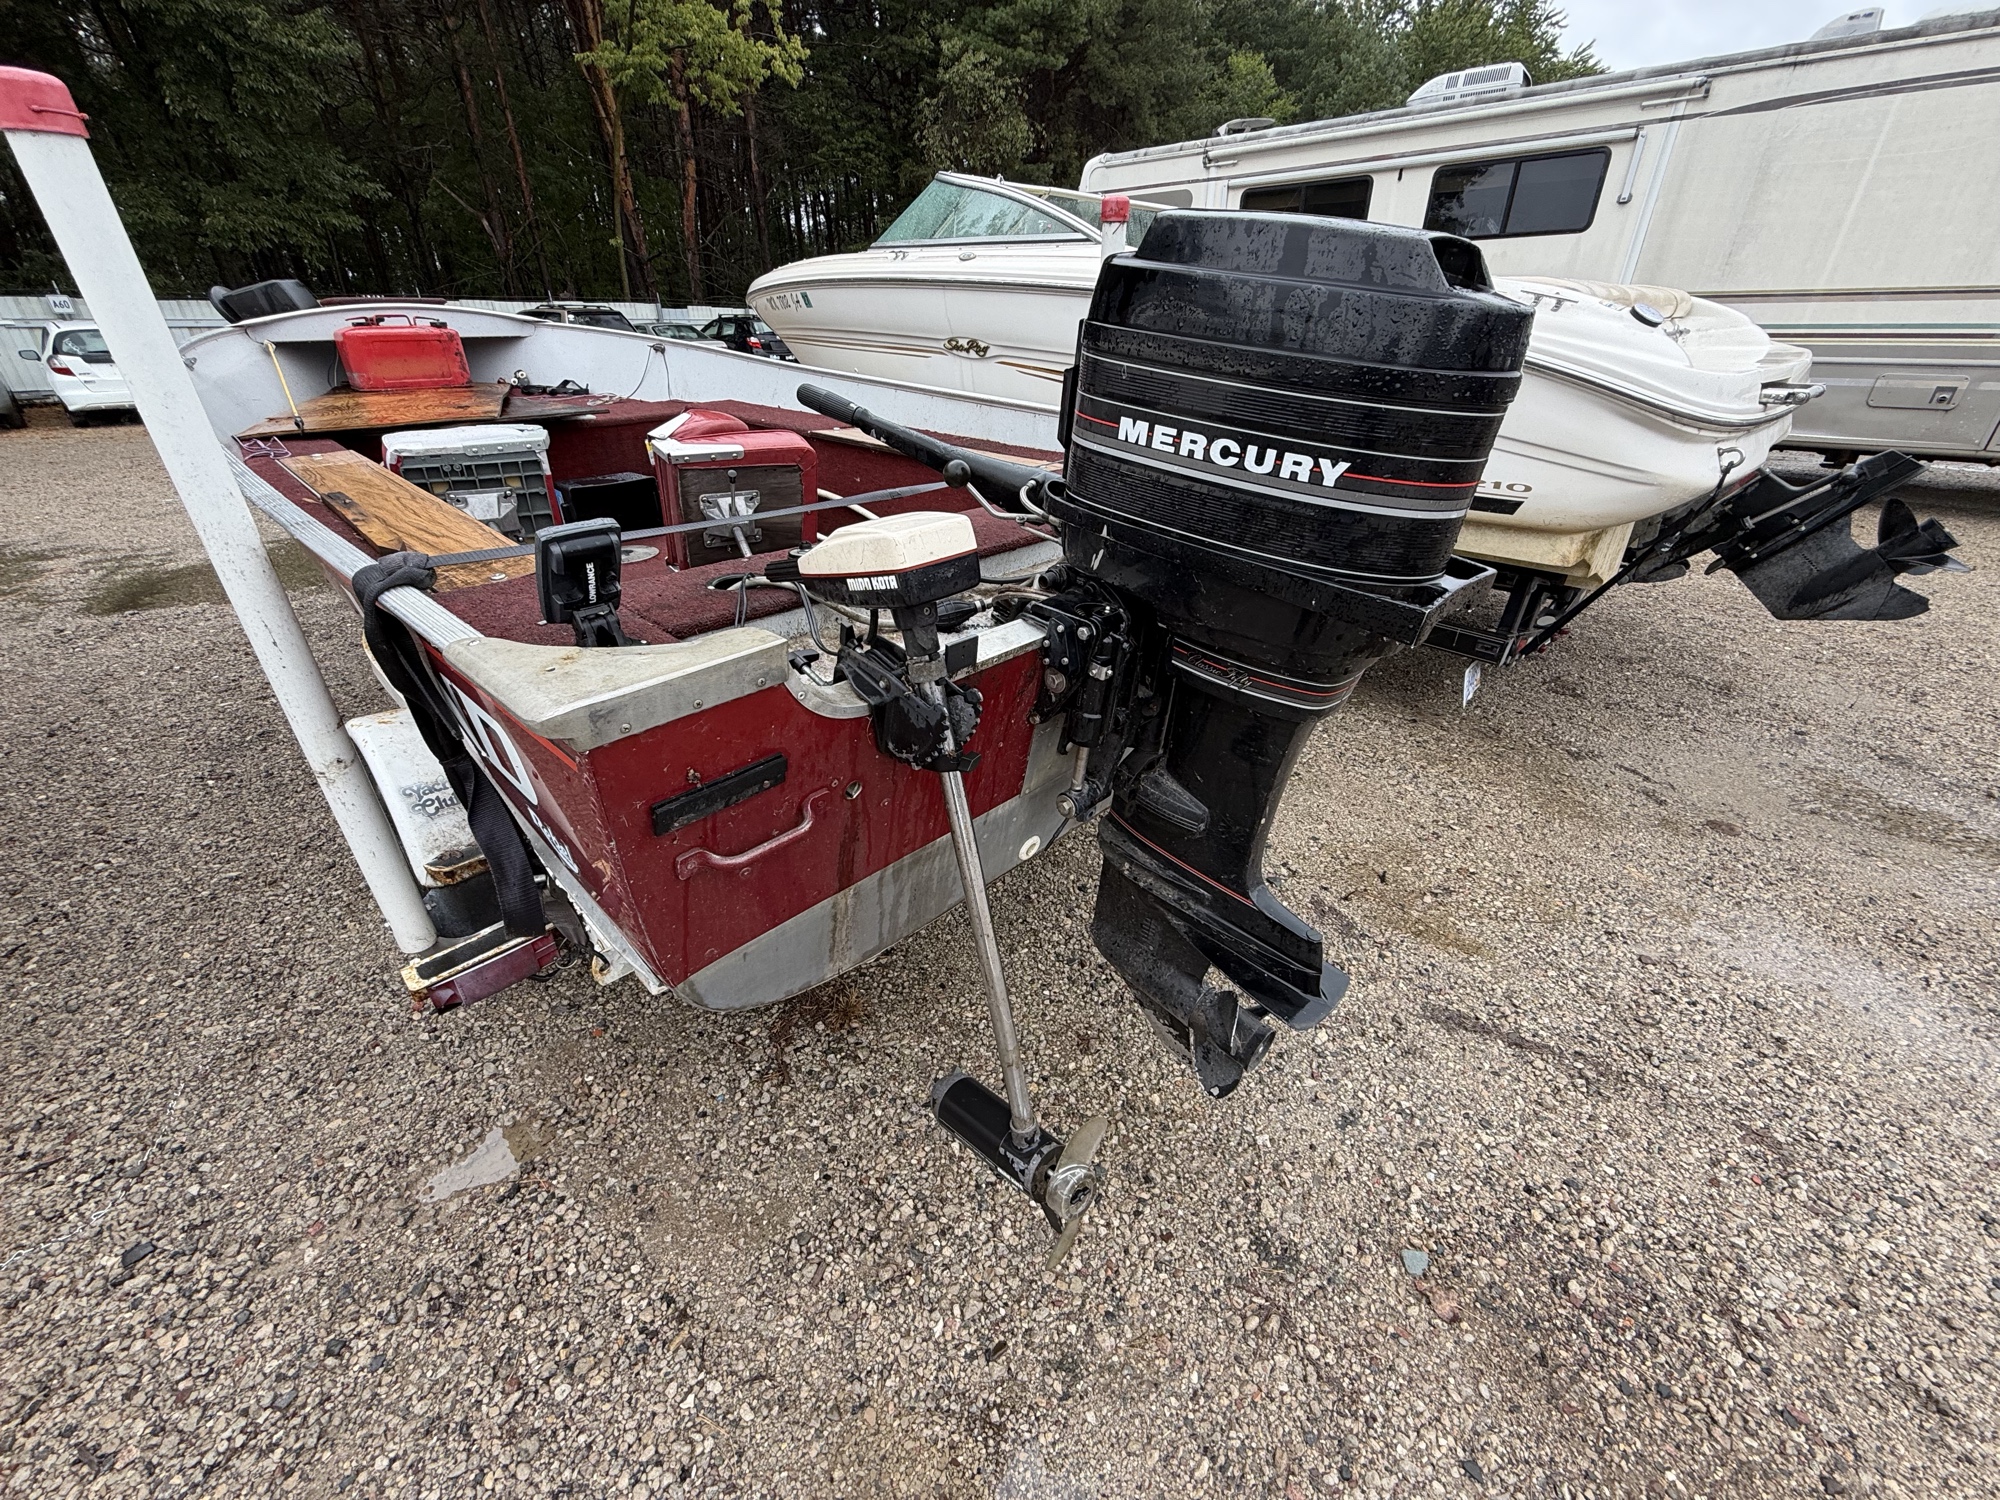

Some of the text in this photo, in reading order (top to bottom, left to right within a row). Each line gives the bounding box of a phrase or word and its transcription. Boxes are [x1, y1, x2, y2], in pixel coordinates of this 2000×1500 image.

[52, 300, 71, 309] A60
[1117, 416, 1351, 488] MERCURY
[586, 562, 597, 604] LOWRANCE
[871, 575, 898, 591] KOTA
[1187, 652, 1253, 691] Classic Fifty
[411, 793, 461, 818] Clu
